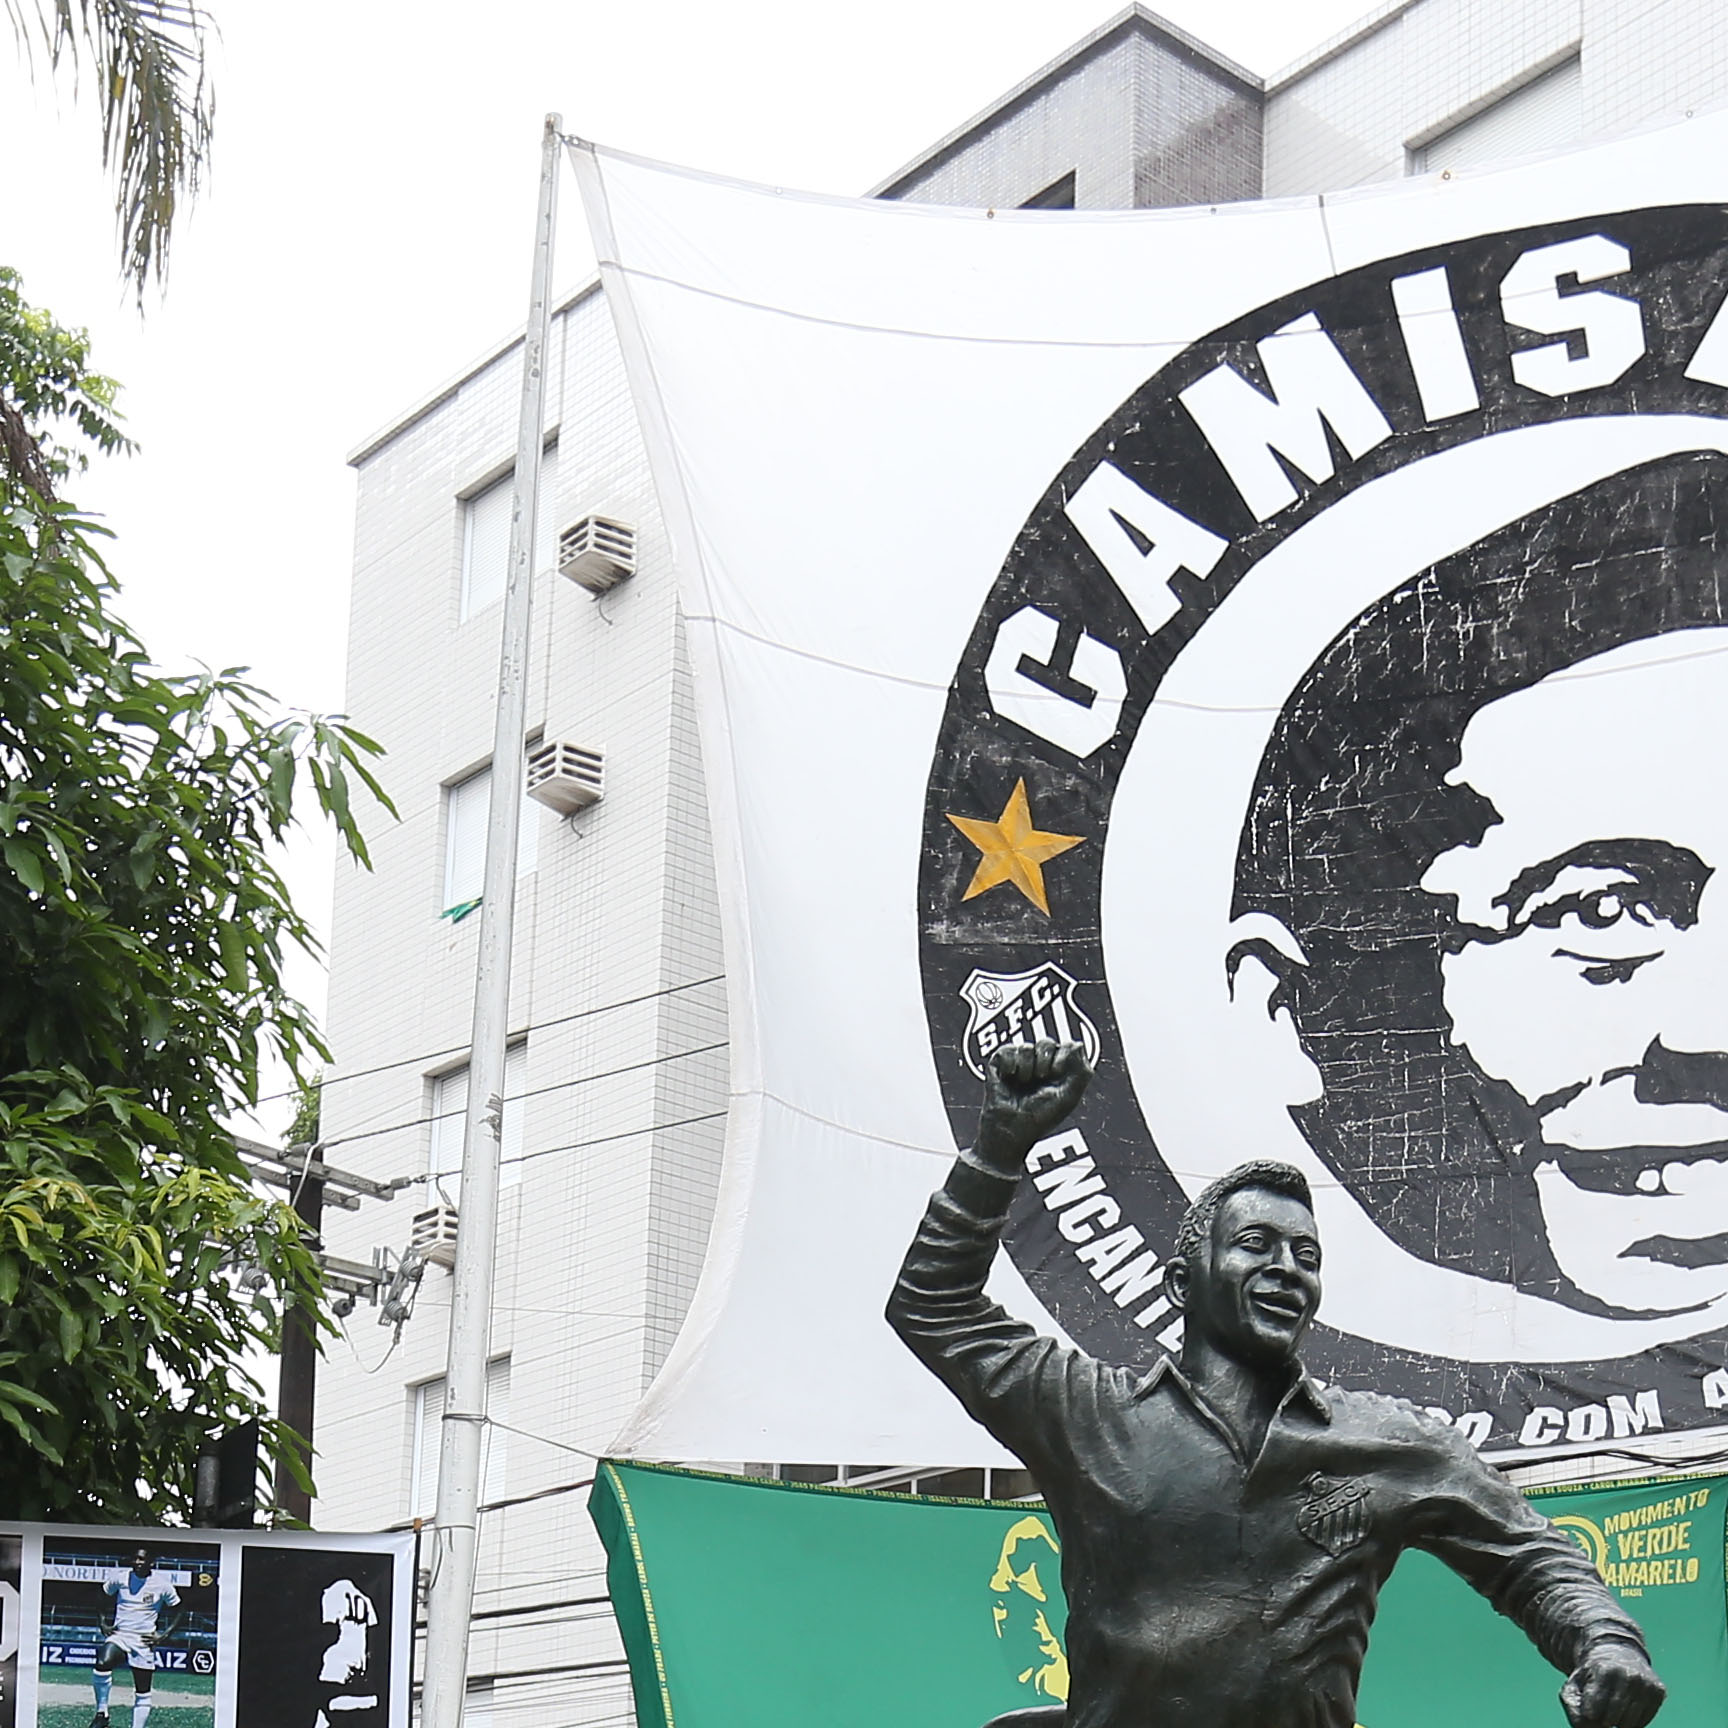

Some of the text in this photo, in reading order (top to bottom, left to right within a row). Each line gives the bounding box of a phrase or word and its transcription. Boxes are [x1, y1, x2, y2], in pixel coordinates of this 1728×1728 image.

[977, 976, 1060, 1057] S.F.C.
[1518, 1389, 1664, 1446] COM
[1604, 1488, 1710, 1537] MOVIMENTO
[1617, 1521, 1692, 1559] VERDE
[1604, 1557, 1699, 1587] AMARELO
